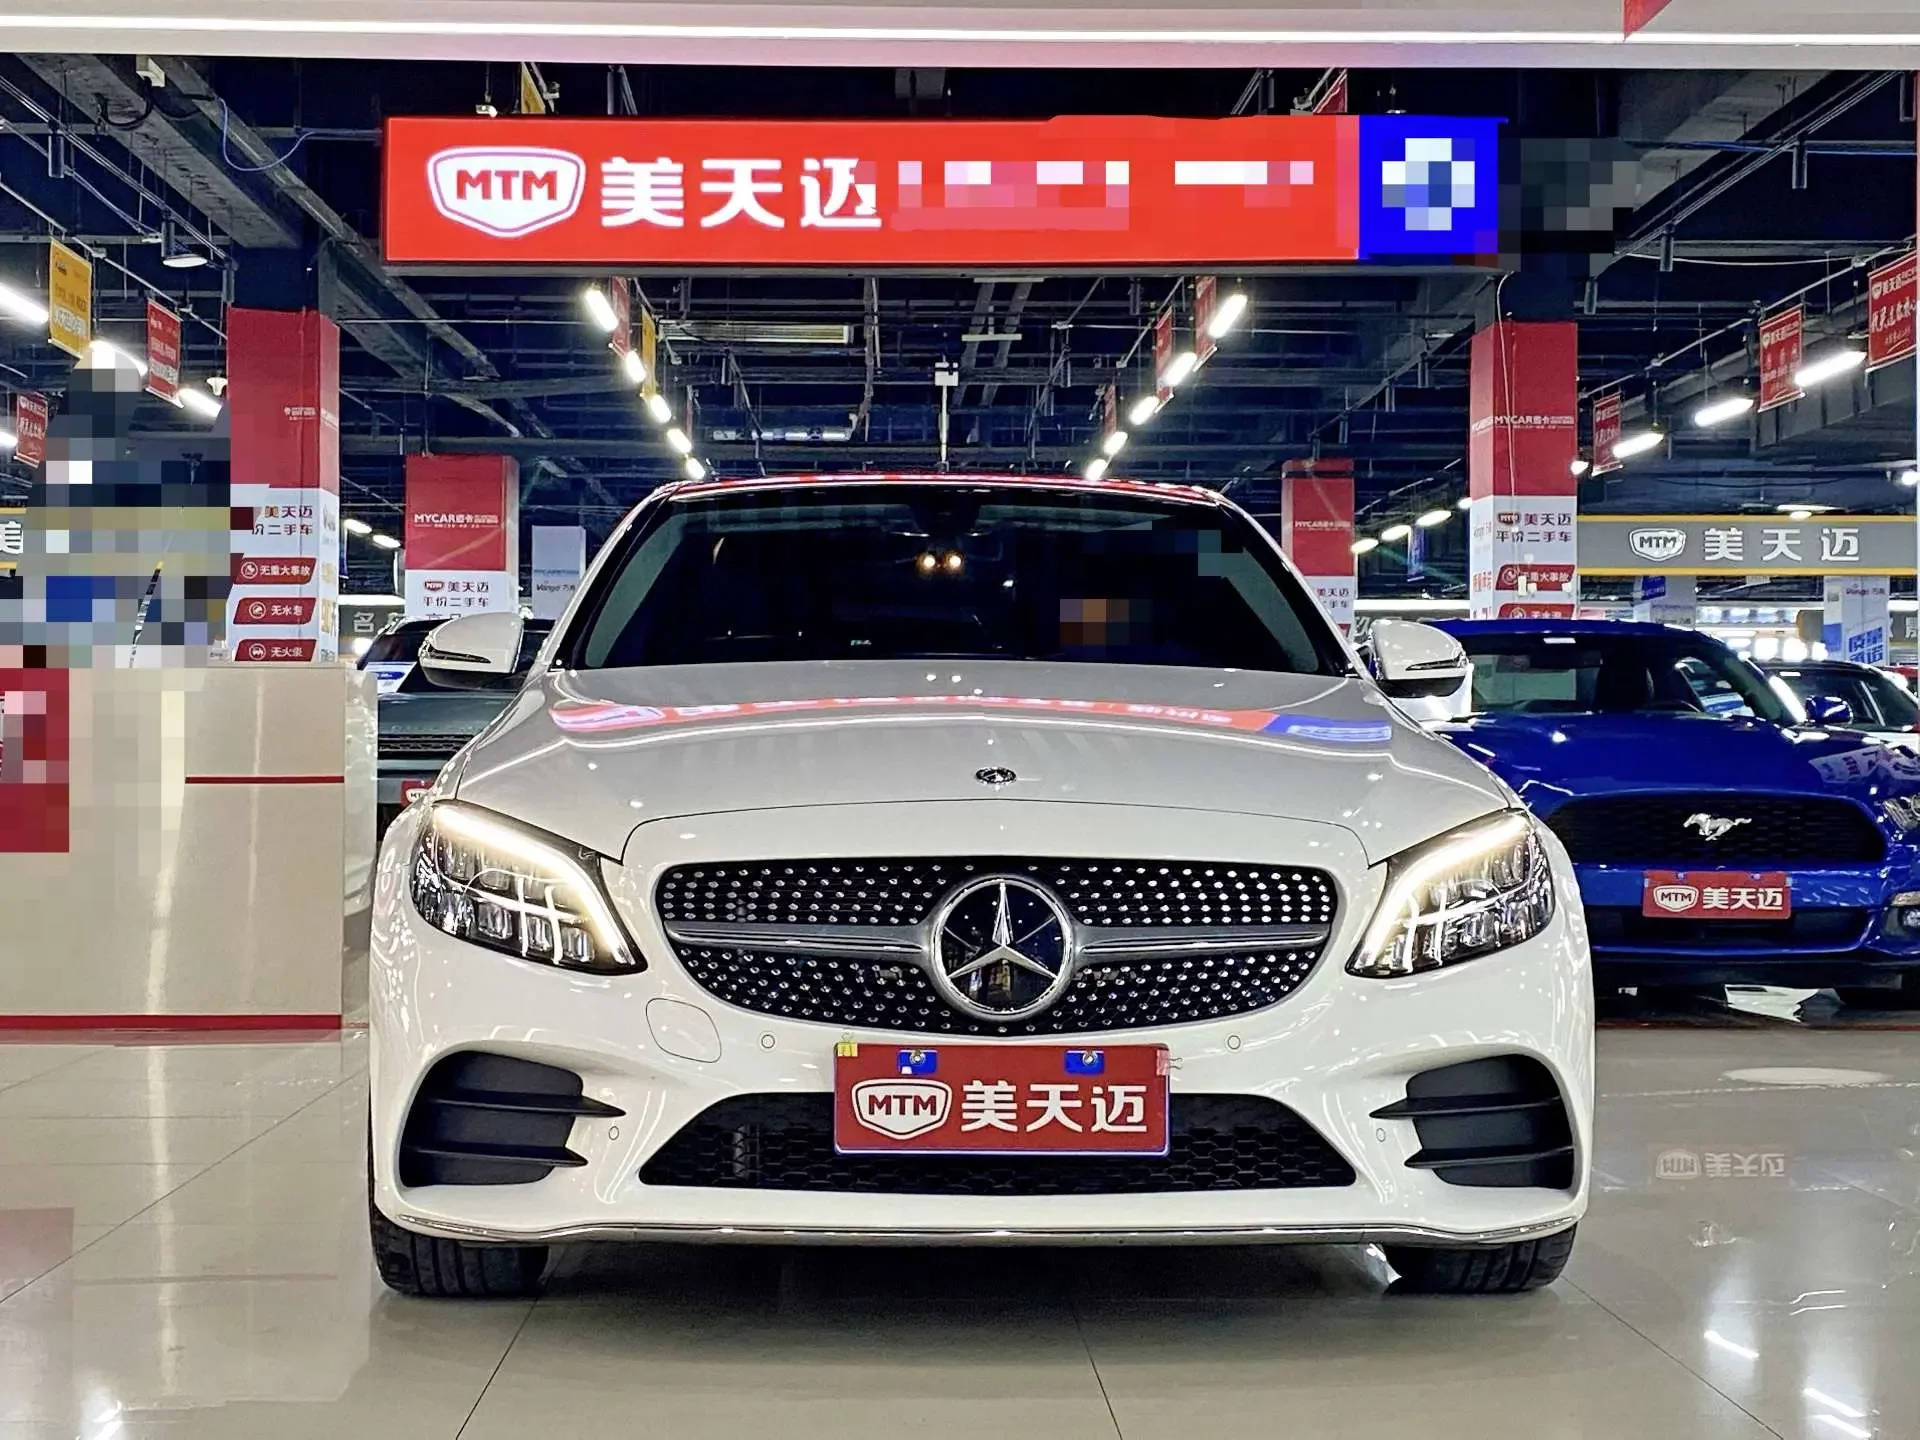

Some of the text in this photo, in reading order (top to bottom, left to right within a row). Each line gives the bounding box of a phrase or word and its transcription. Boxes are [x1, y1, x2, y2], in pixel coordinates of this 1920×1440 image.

[456, 156, 882, 228] MTM 美天迈
[265, 505, 313, 519] 美天迈
[414, 513, 457, 524] MYCAR
[1524, 512, 1572, 526] 美天迈
[1496, 530, 1572, 542] 平价二手车
[1639, 527, 1860, 561] MTM 美天迈
[447, 581, 489, 592] 美天迈
[424, 596, 489, 607] 平价二手车
[1660, 886, 1784, 910] MTM 美天迈
[868, 1080, 1148, 1132] MTM 美天迈
